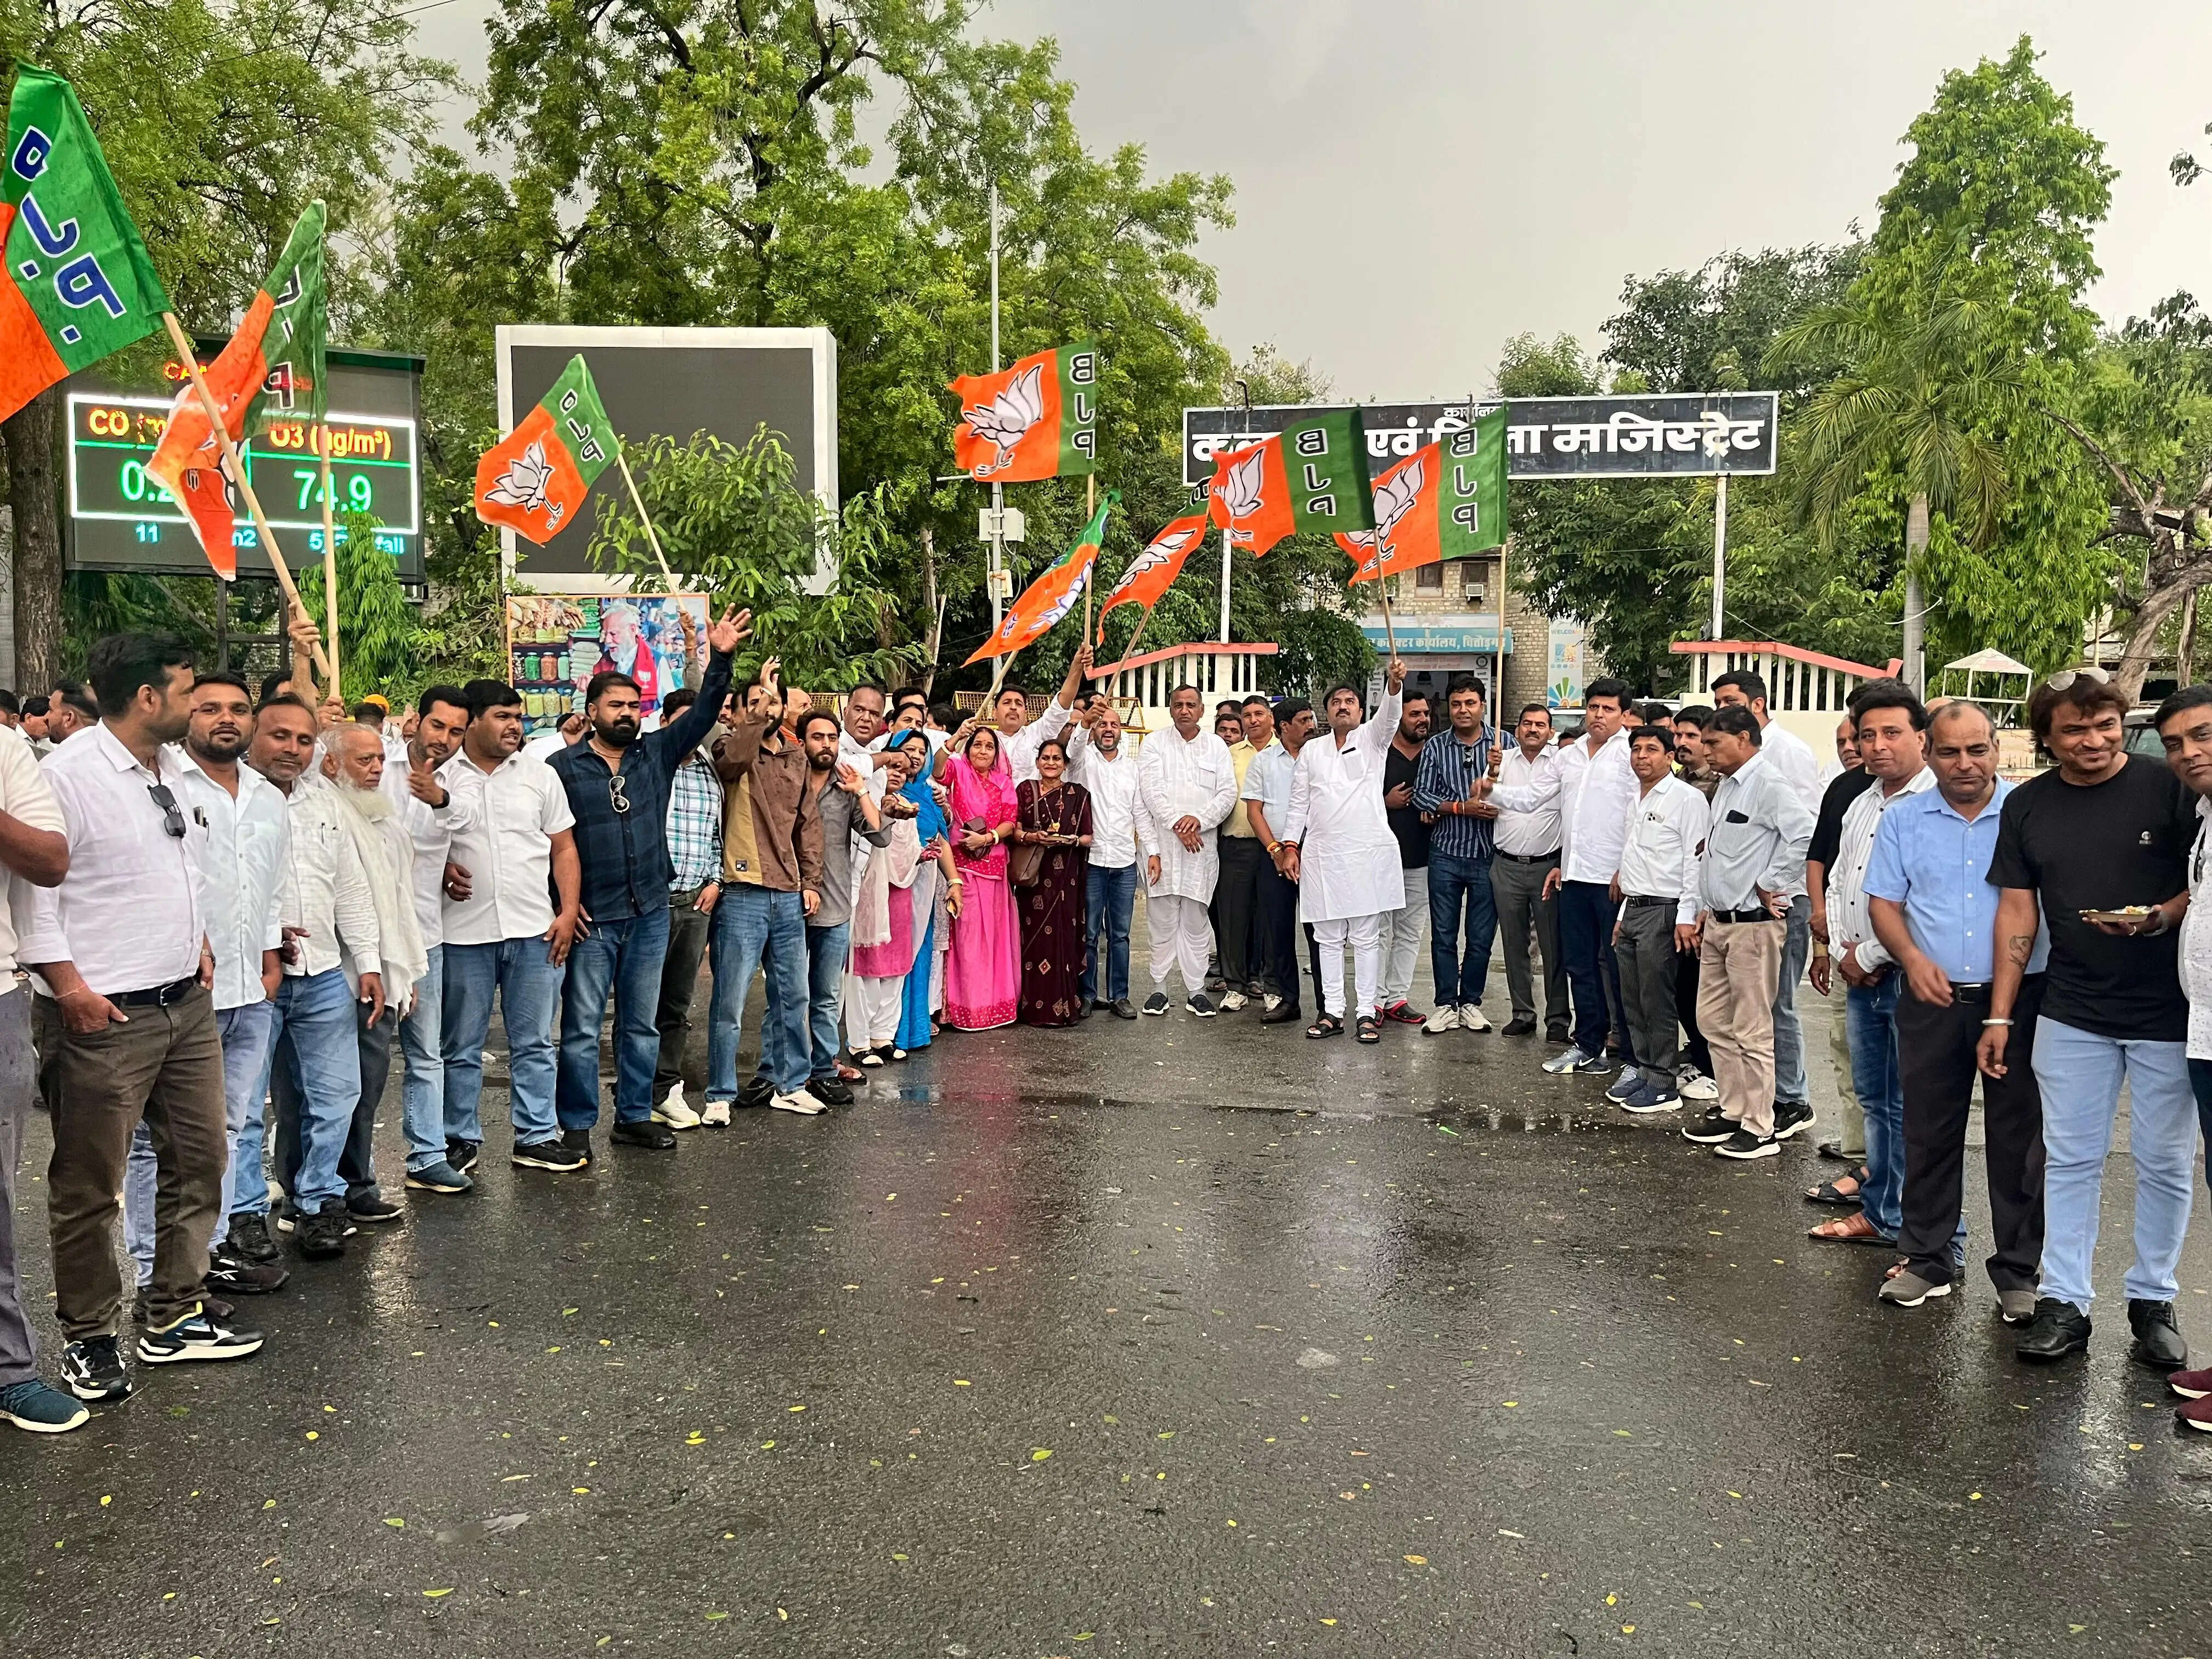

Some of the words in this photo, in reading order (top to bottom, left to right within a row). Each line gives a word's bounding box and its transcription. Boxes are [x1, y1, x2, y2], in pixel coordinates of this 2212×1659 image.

[89, 409, 130, 437] CO
[1364, 416, 1424, 458] एवं
[293, 470, 373, 512] 74.9
[135, 522, 160, 543] 11
